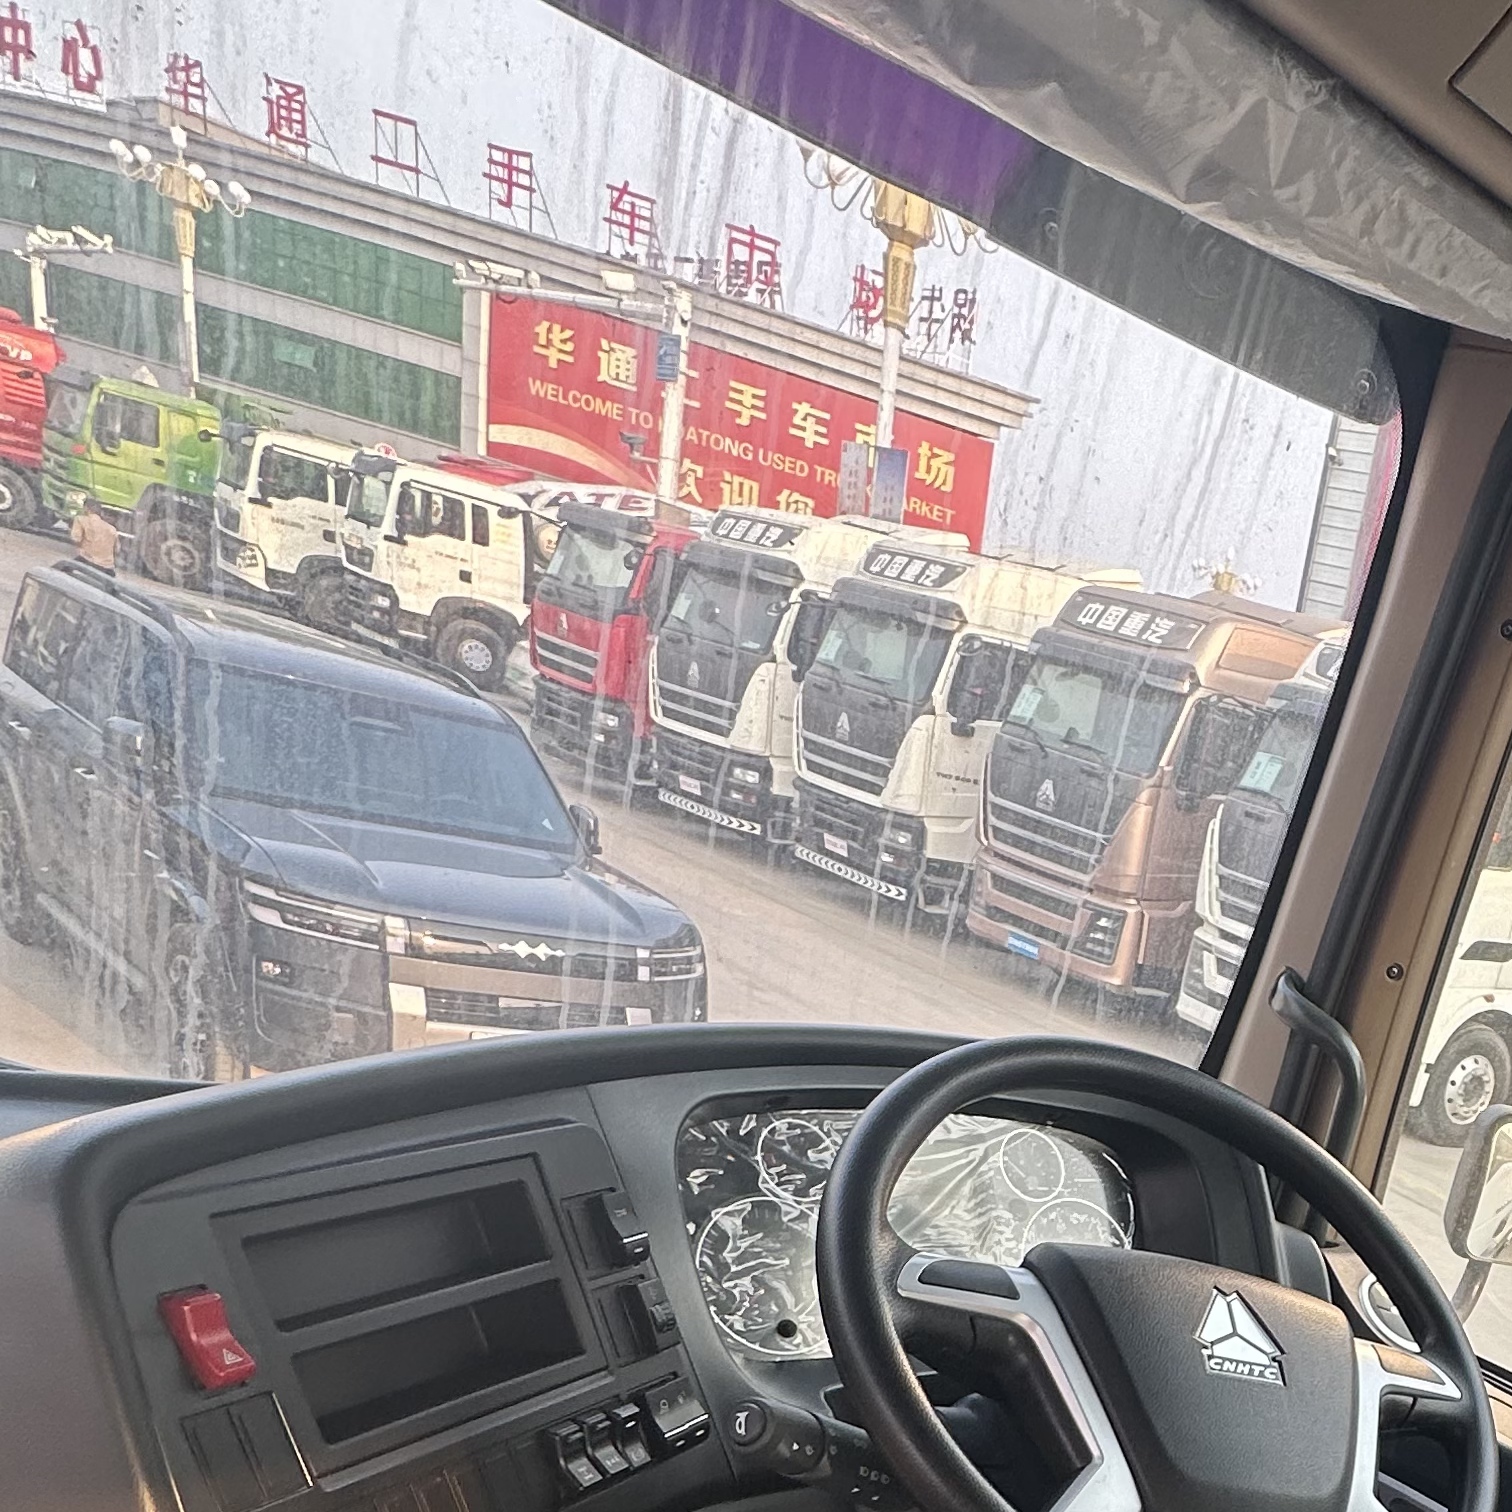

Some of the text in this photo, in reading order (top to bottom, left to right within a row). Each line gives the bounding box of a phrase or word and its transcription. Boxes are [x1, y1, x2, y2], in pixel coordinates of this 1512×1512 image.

[528, 377, 956, 525] WELCOME TO ATONG USED RKET
[870, 553, 946, 587] 中国重汽
[1077, 602, 1176, 643] 中国重汽
[1209, 1358, 1278, 1379] CNHTC
